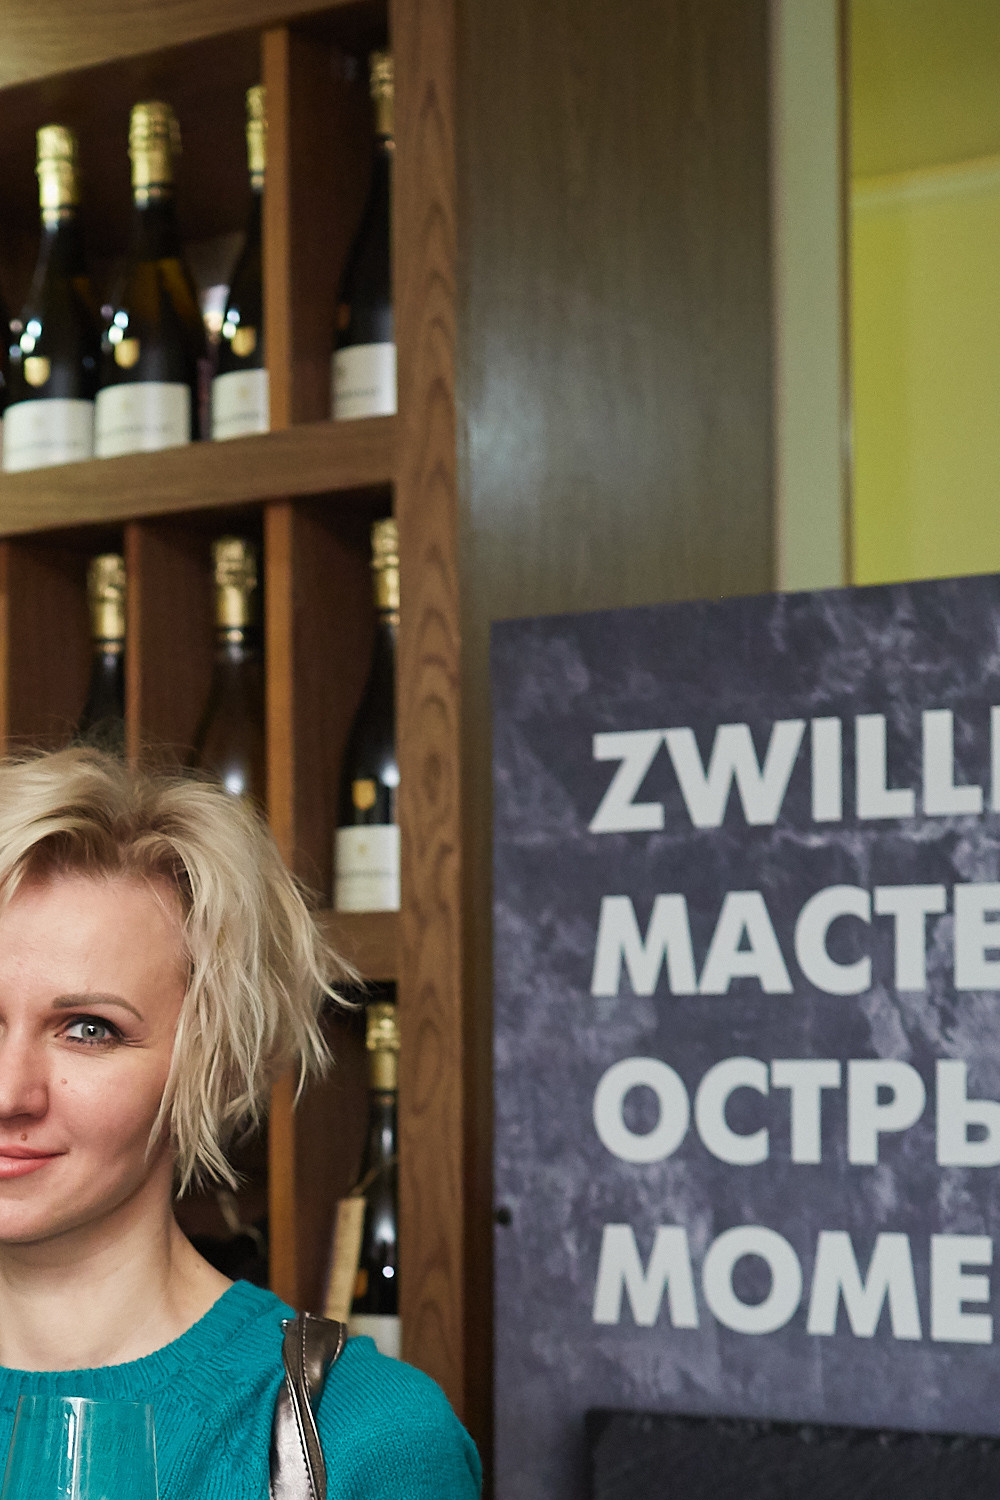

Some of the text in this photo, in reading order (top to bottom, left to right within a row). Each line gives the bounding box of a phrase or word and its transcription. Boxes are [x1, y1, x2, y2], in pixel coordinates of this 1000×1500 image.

[589, 704, 1000, 834] ZWILL
[591, 882, 1000, 997] МАСТЕ
[592, 1223, 994, 1345] МОМЕ
